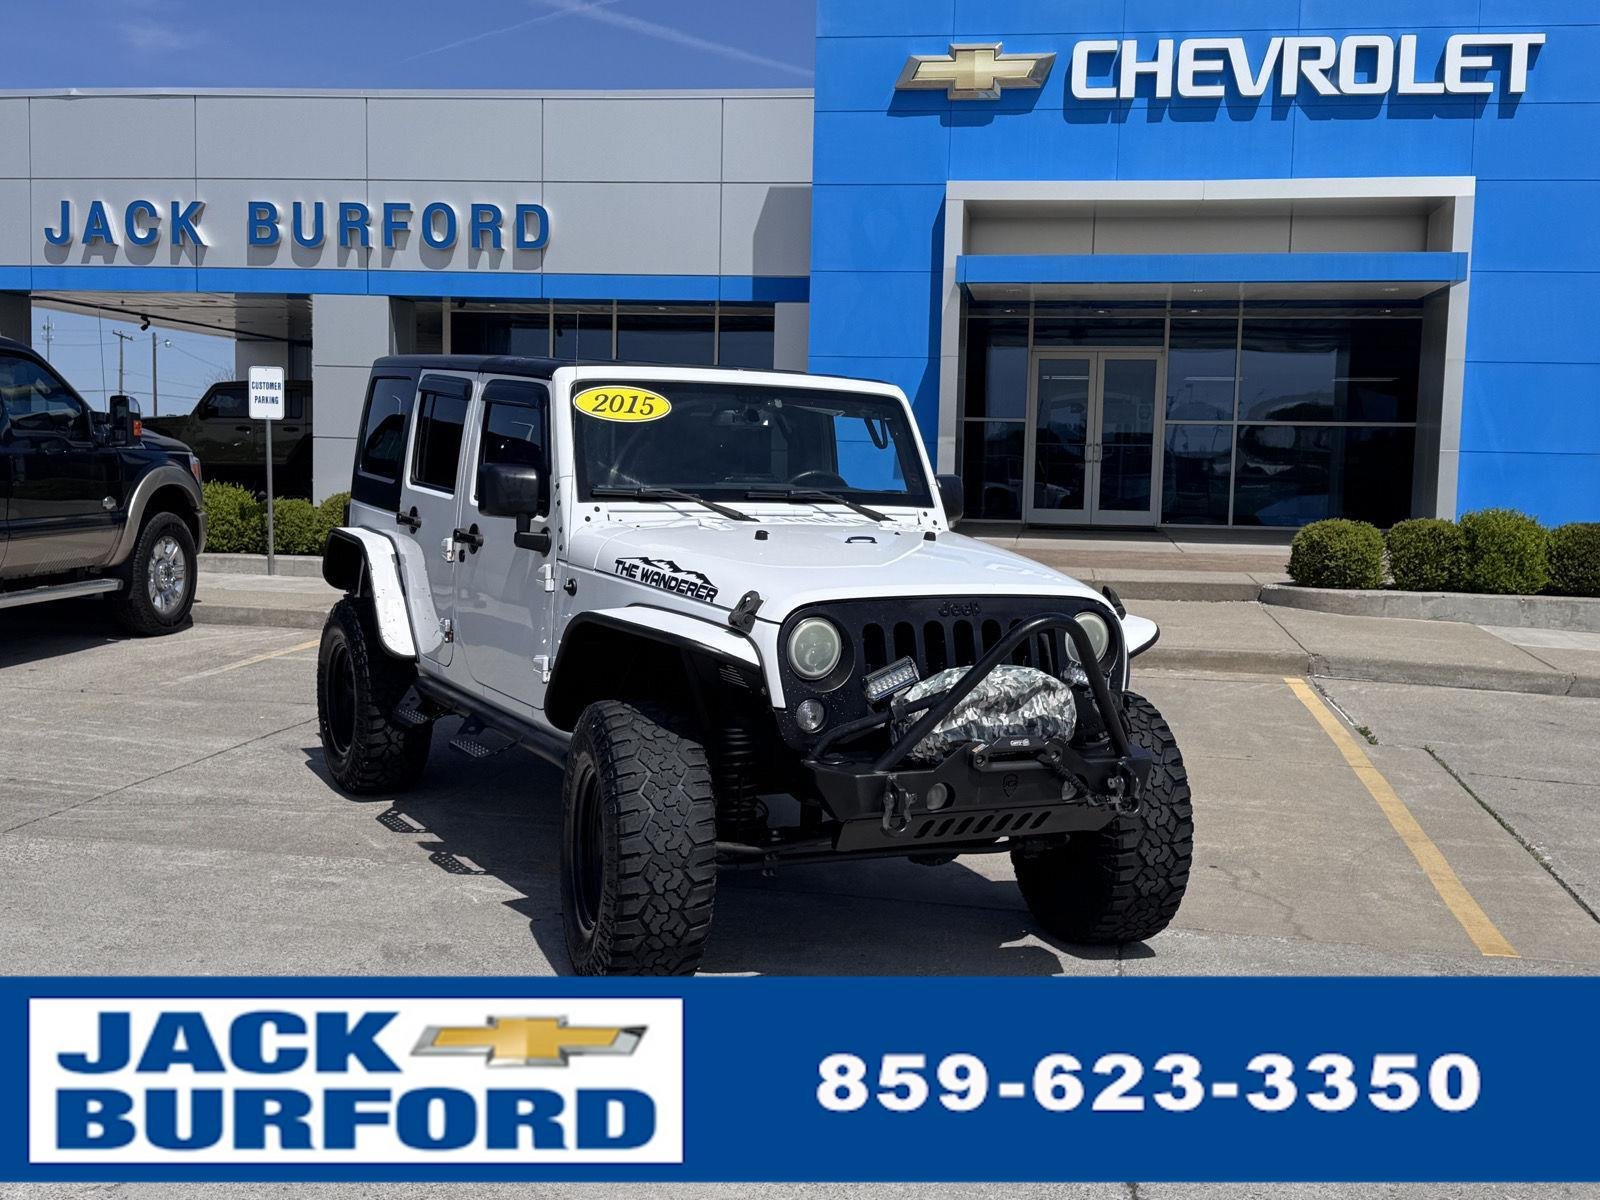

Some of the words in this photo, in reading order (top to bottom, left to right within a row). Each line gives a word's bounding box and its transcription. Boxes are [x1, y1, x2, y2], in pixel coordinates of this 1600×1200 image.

[1071, 33, 1546, 99] CHEVROLET
[45, 199, 206, 247] JACK
[248, 200, 551, 251] BURFORD
[251, 381, 282, 390] CUSTOMER
[254, 395, 279, 404] PARKING
[592, 393, 655, 415] 2015
[615, 559, 640, 580] THE
[640, 567, 719, 602] WANDERER
[938, 600, 981, 617] Jeep
